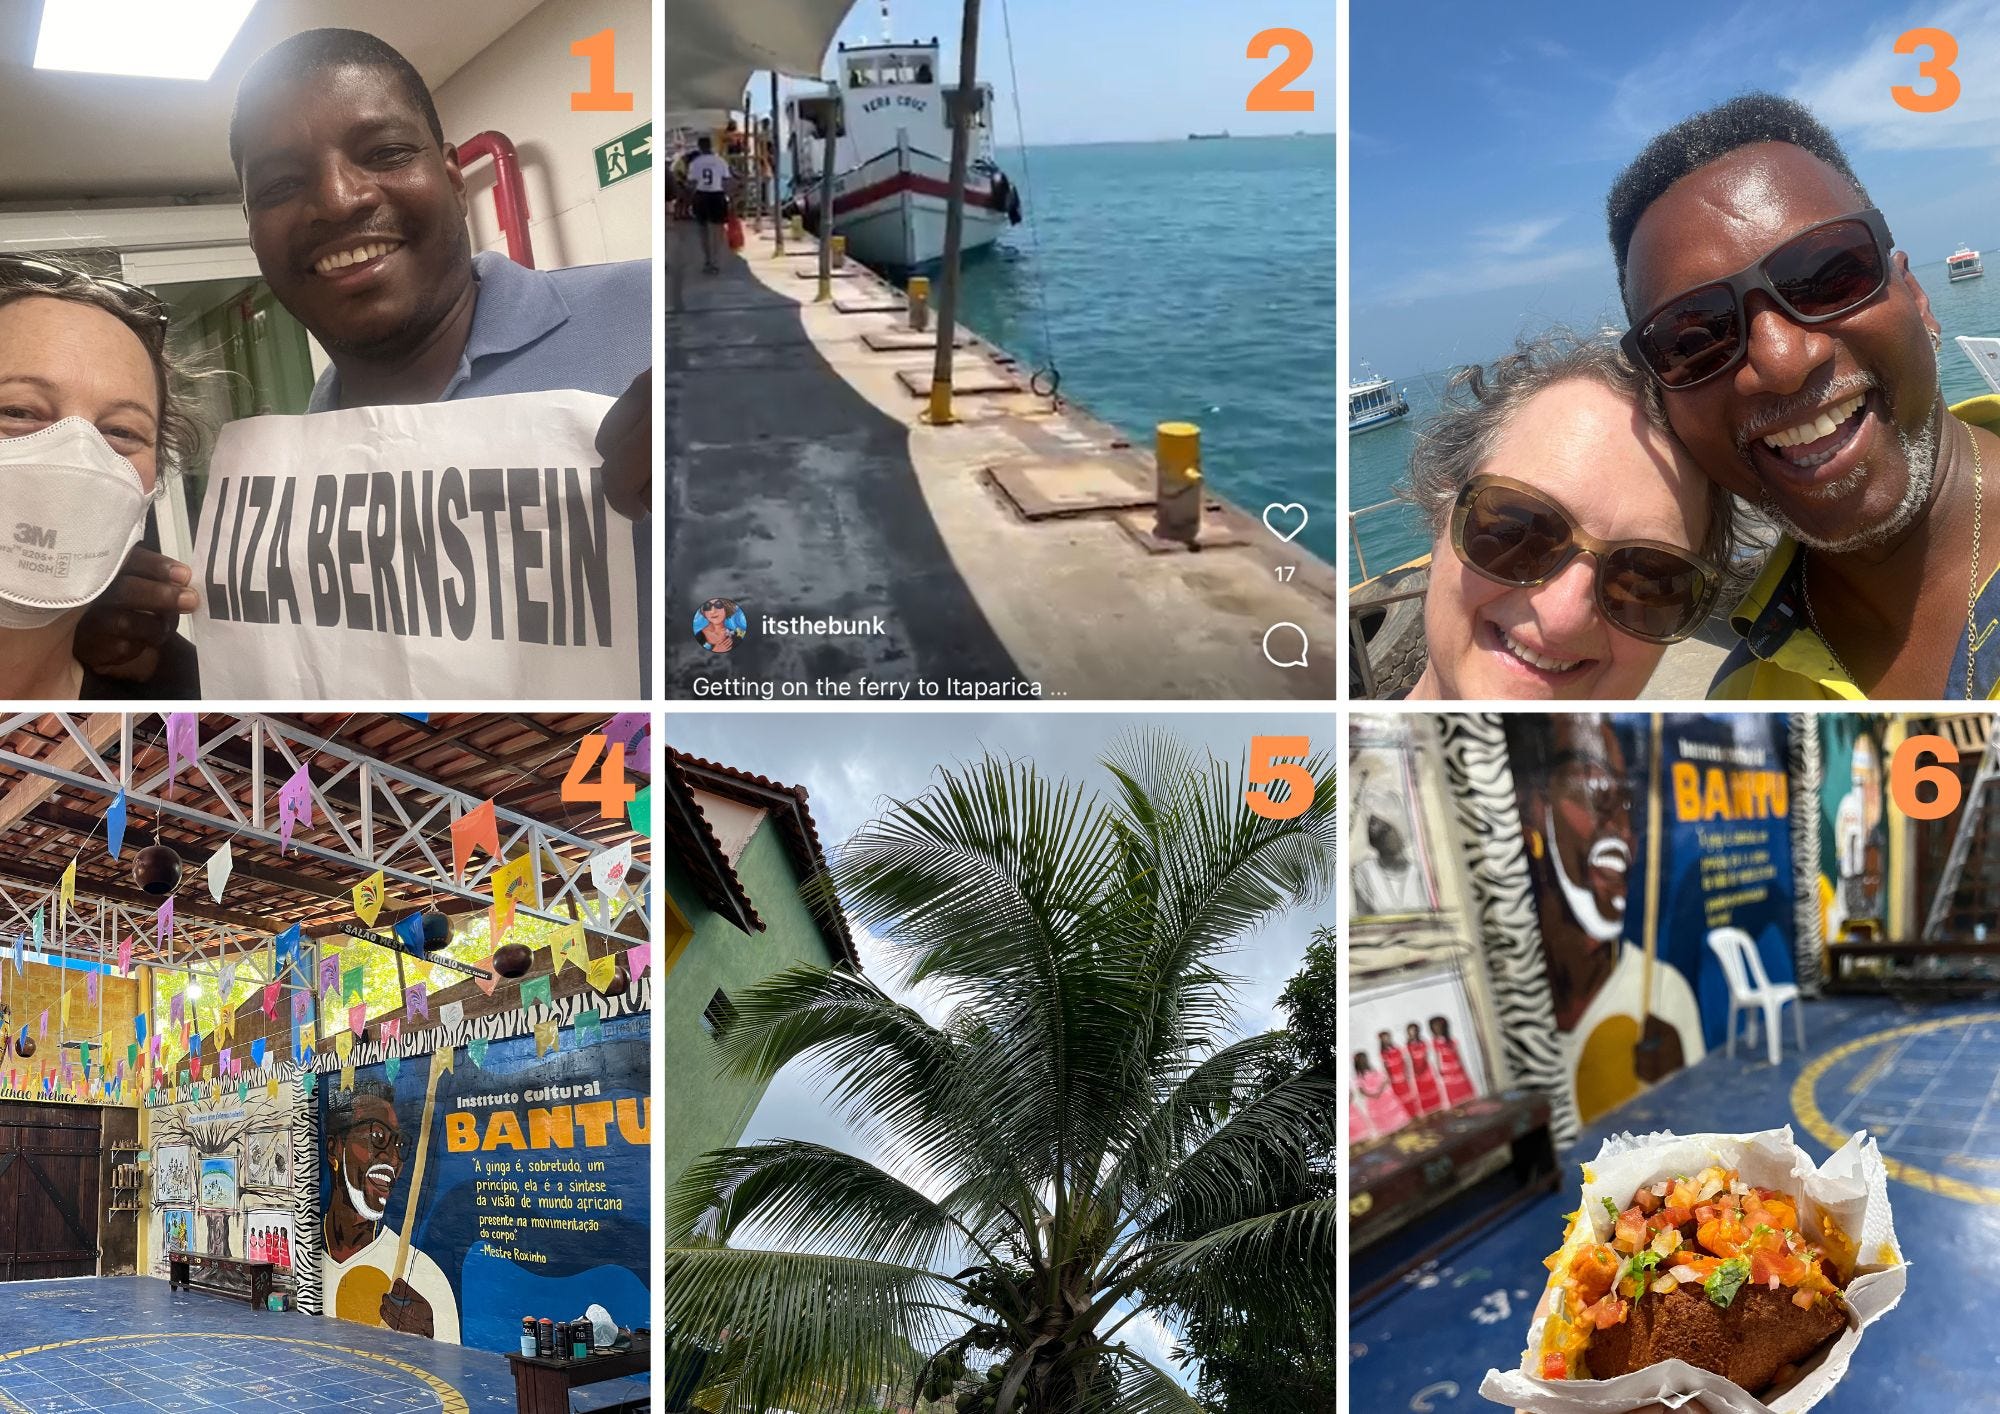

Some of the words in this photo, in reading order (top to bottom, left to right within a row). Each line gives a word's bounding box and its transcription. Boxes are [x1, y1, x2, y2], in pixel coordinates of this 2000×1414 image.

[862, 96, 891, 113] VERA
[897, 95, 928, 112] CRUZ
[702, 168, 713, 185] 9
[13, 522, 58, 550] 3M
[205, 475, 302, 625] LIZA
[307, 466, 612, 648] BERNSTEIN
[18, 559, 54, 574] NIOSH
[456, 1091, 519, 1109] Instituto
[523, 1080, 601, 1102] Cultural
[445, 1097, 651, 1153] BANTU
[485, 1160, 511, 1176] ginga
[515, 1158, 524, 1173] é,
[528, 1159, 582, 1174] sobretudo,
[588, 1161, 605, 1172] um
[524, 1178, 538, 1192] ela
[544, 1178, 551, 1192] é
[557, 1182, 563, 1192] a
[476, 1194, 487, 1206] da
[491, 1194, 515, 1208] visão
[520, 1194, 531, 1208] de
[538, 1195, 573, 1209] mundo
[577, 1198, 623, 1213] africana
[479, 1214, 514, 1228] presente
[517, 1217, 528, 1228] na
[531, 1216, 600, 1233] movimentação
[479, 1228, 490, 1238] do
[513, 1248, 547, 1264] Roxinho
